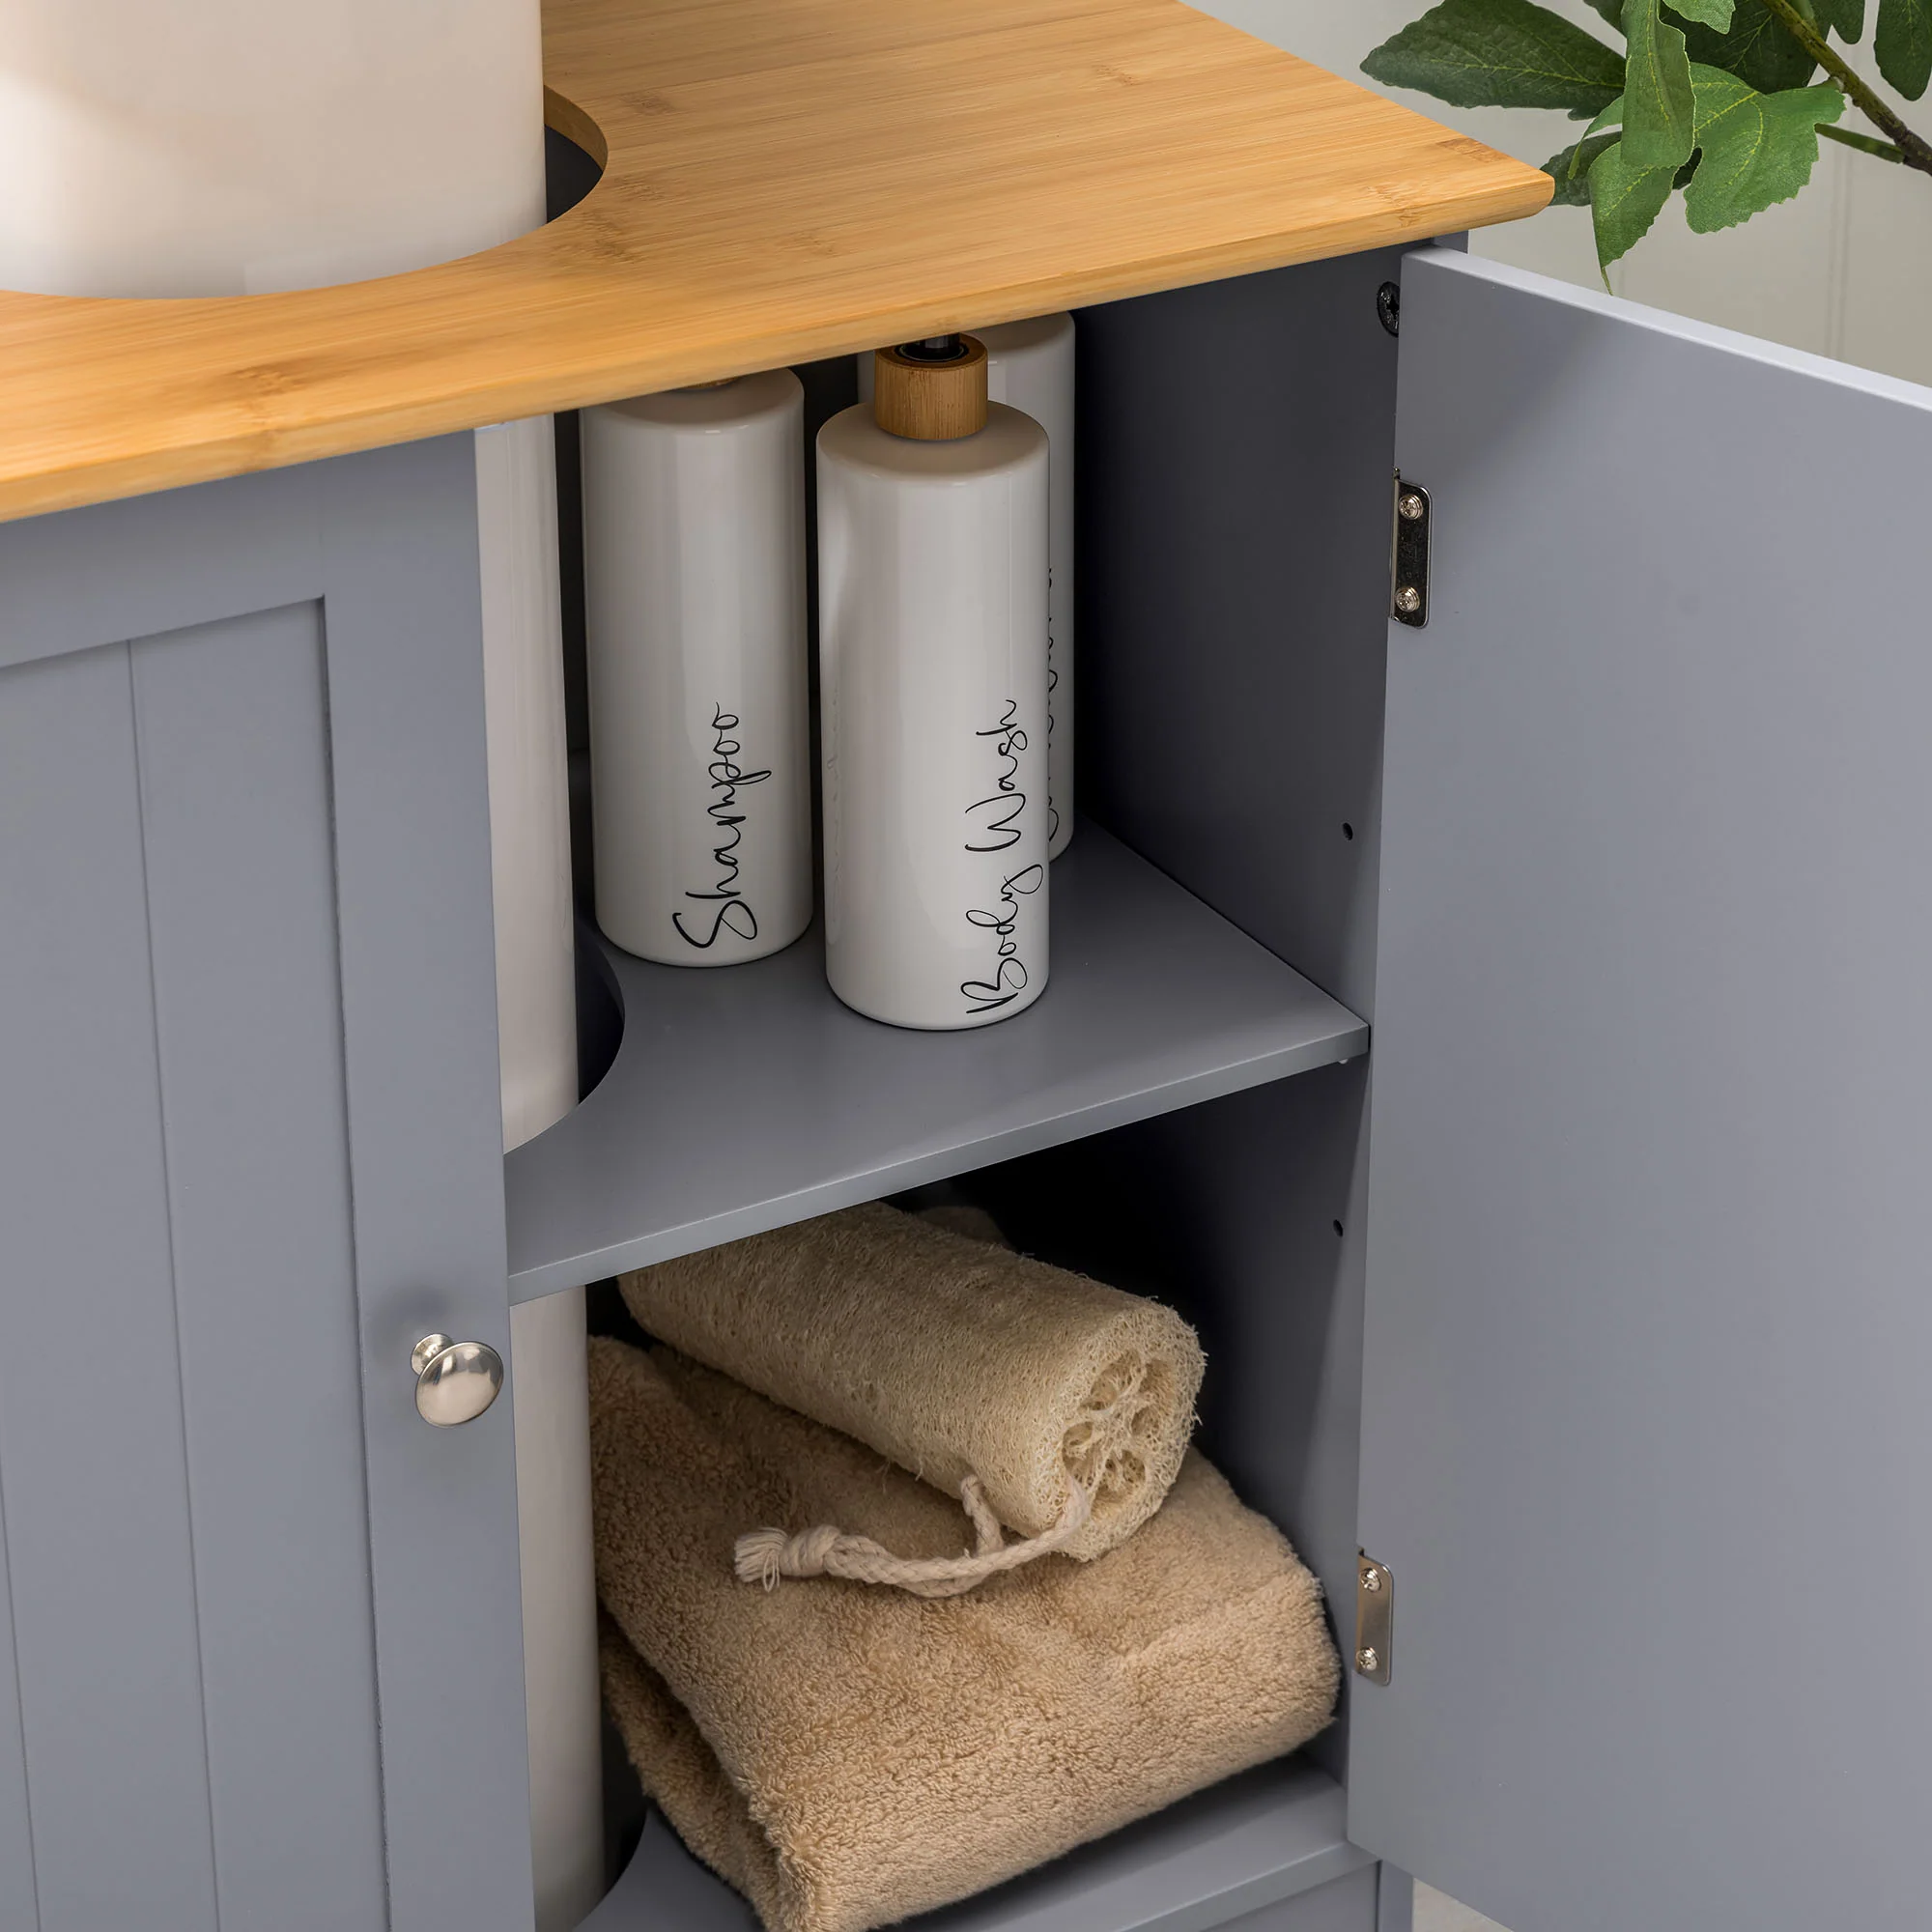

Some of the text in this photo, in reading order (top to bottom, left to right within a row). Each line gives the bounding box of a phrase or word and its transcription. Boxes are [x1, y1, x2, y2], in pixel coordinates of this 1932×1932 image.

[672, 701, 773, 949] Shampoo
[961, 699, 1043, 1014] Body Wash
